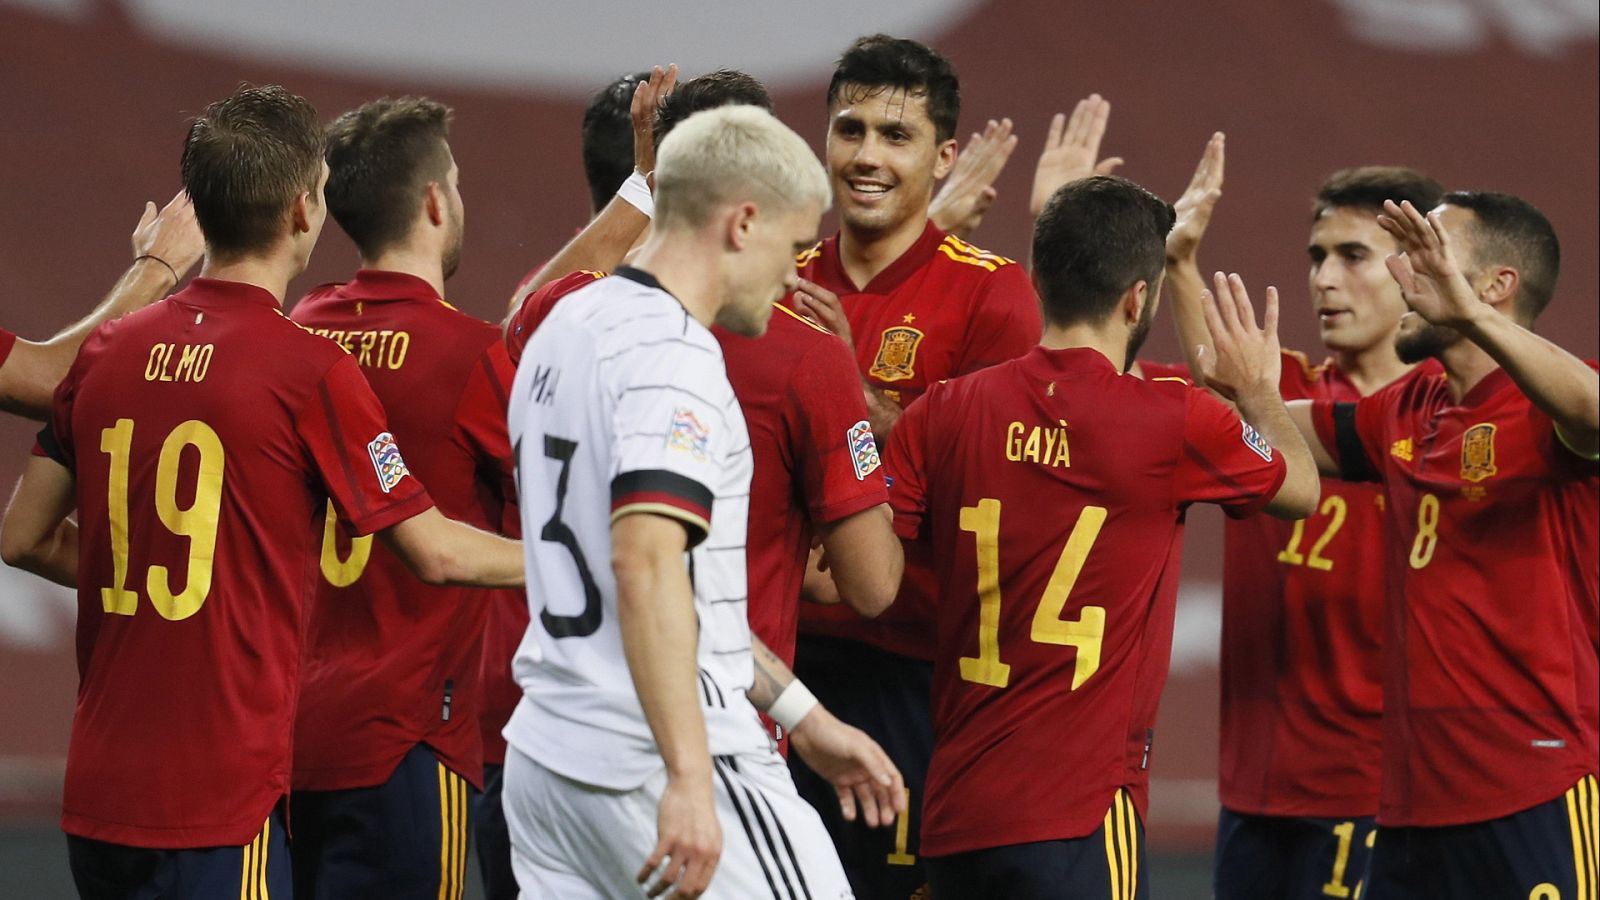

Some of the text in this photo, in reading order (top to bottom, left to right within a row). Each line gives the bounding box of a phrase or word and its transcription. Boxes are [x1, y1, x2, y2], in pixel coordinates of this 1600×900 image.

[143, 342, 214, 384] OLMO
[1006, 418, 1071, 468] GAYÀ
[100, 418, 225, 621] 19
[1277, 495, 1347, 571] 12
[1409, 493, 1440, 569] 8
[959, 498, 1108, 691] 14
